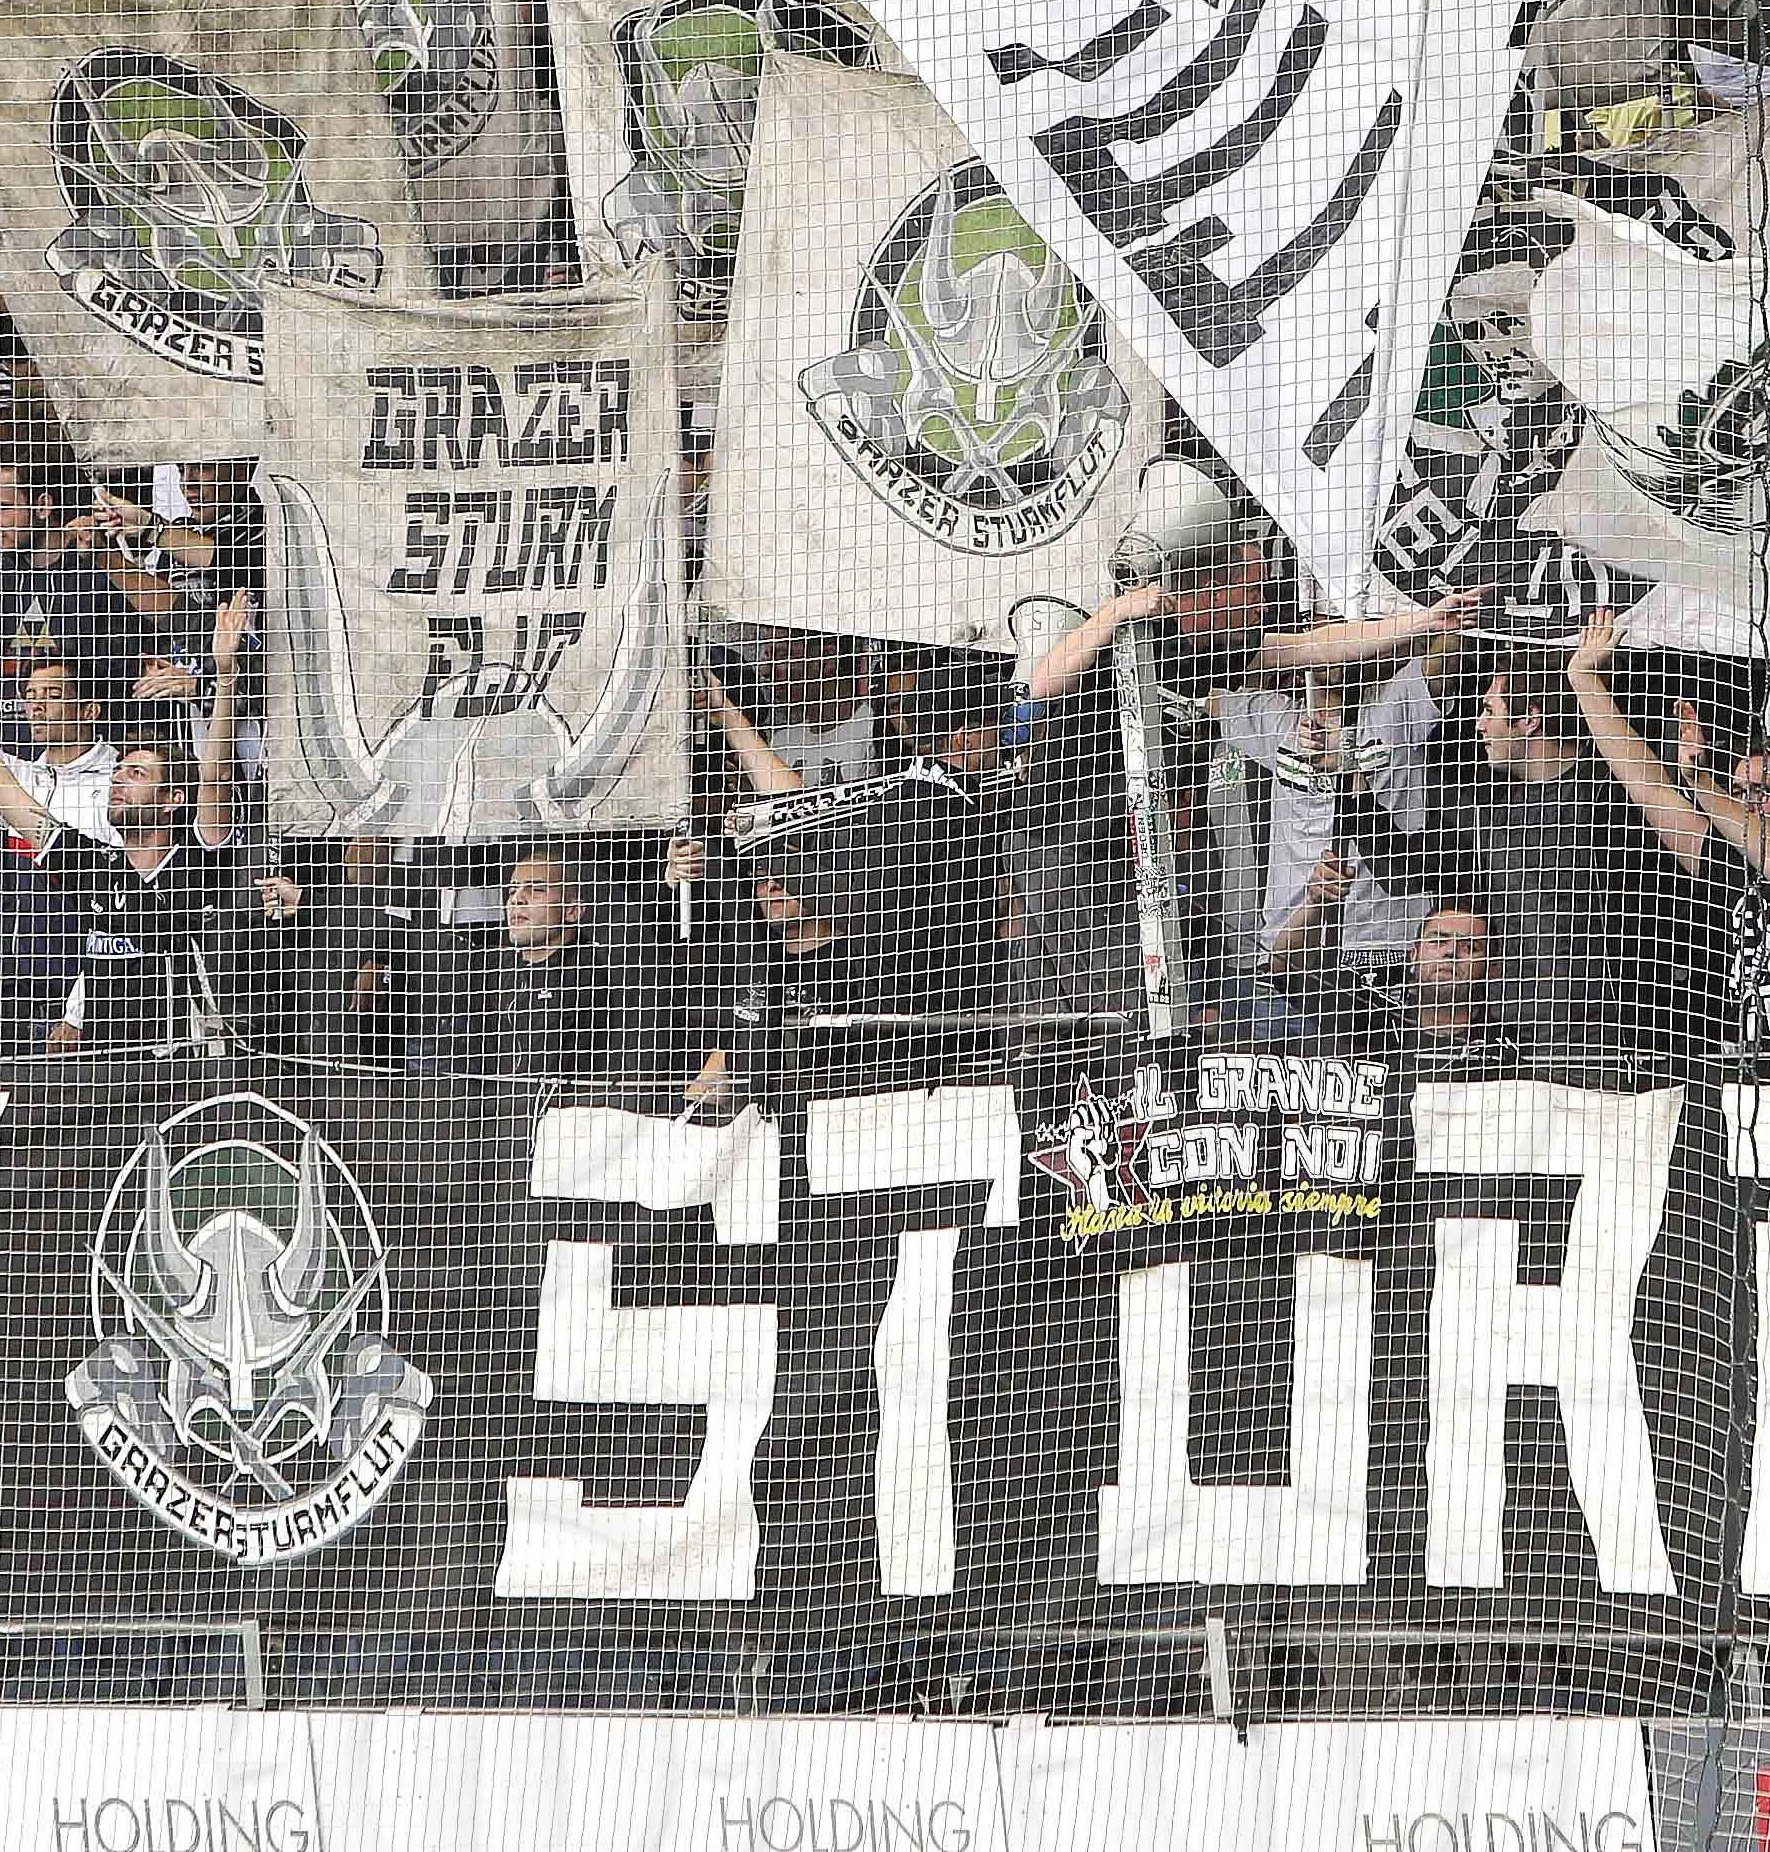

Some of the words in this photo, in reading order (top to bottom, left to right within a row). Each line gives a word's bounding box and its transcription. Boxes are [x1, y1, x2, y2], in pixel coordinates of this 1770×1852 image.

[90, 276, 237, 371] GRAZER
[361, 359, 629, 470] GRAZER
[837, 414, 960, 537] GRAZER
[972, 437, 1108, 548] STURMFLUT
[386, 484, 618, 596] STURM
[1196, 1054, 1389, 1116] GRANDE
[1146, 1125, 1257, 1187] CON
[1279, 1123, 1386, 1186] NOI
[53, 1796, 312, 1851] HOLDING
[720, 1796, 970, 1851] HOLDING
[1363, 1810, 1645, 1852] HOLDING
